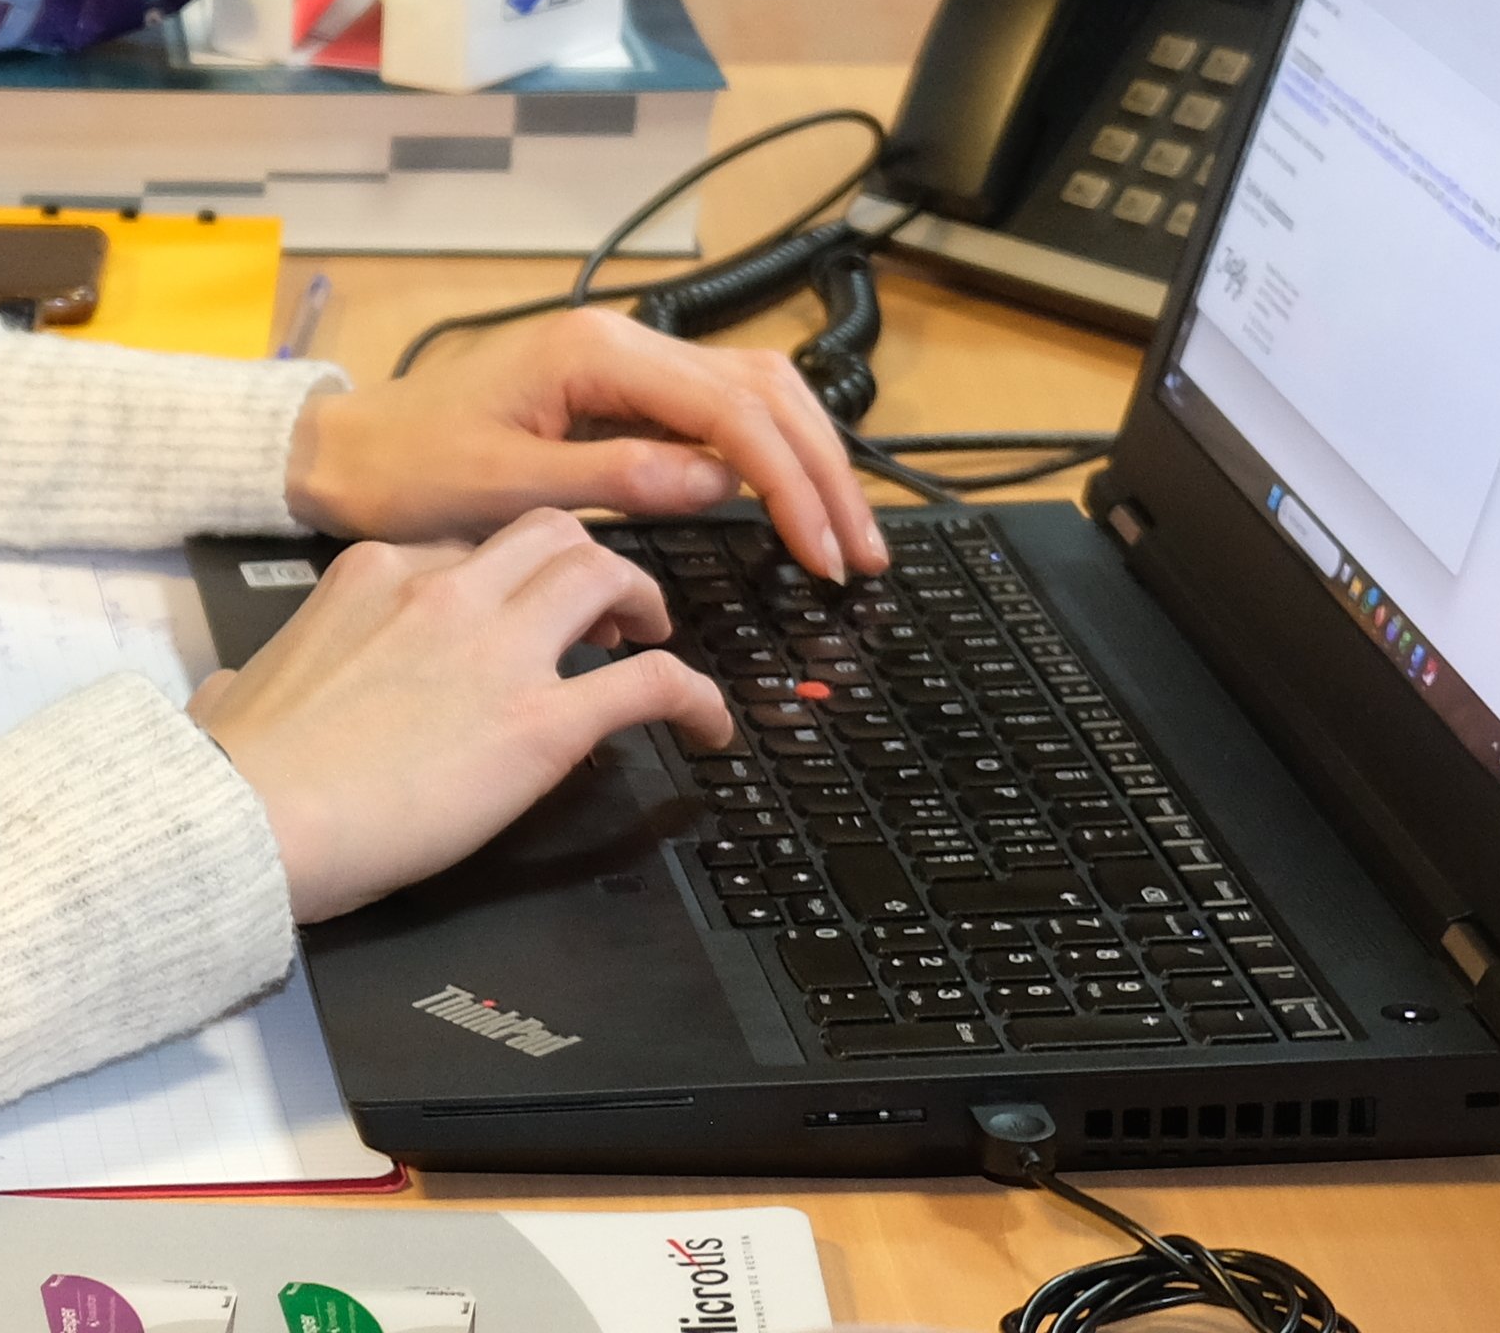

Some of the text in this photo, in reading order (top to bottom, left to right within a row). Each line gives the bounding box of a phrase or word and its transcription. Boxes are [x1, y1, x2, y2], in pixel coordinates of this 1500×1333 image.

[815, 928, 838, 938] 0
[991, 921, 1052, 996] 4 5 6
[1076, 917, 1141, 992] 7 8 9
[919, 956, 943, 967] 2
[937, 989, 962, 999] 3
[410, 984, 583, 1057] ThinkPad
